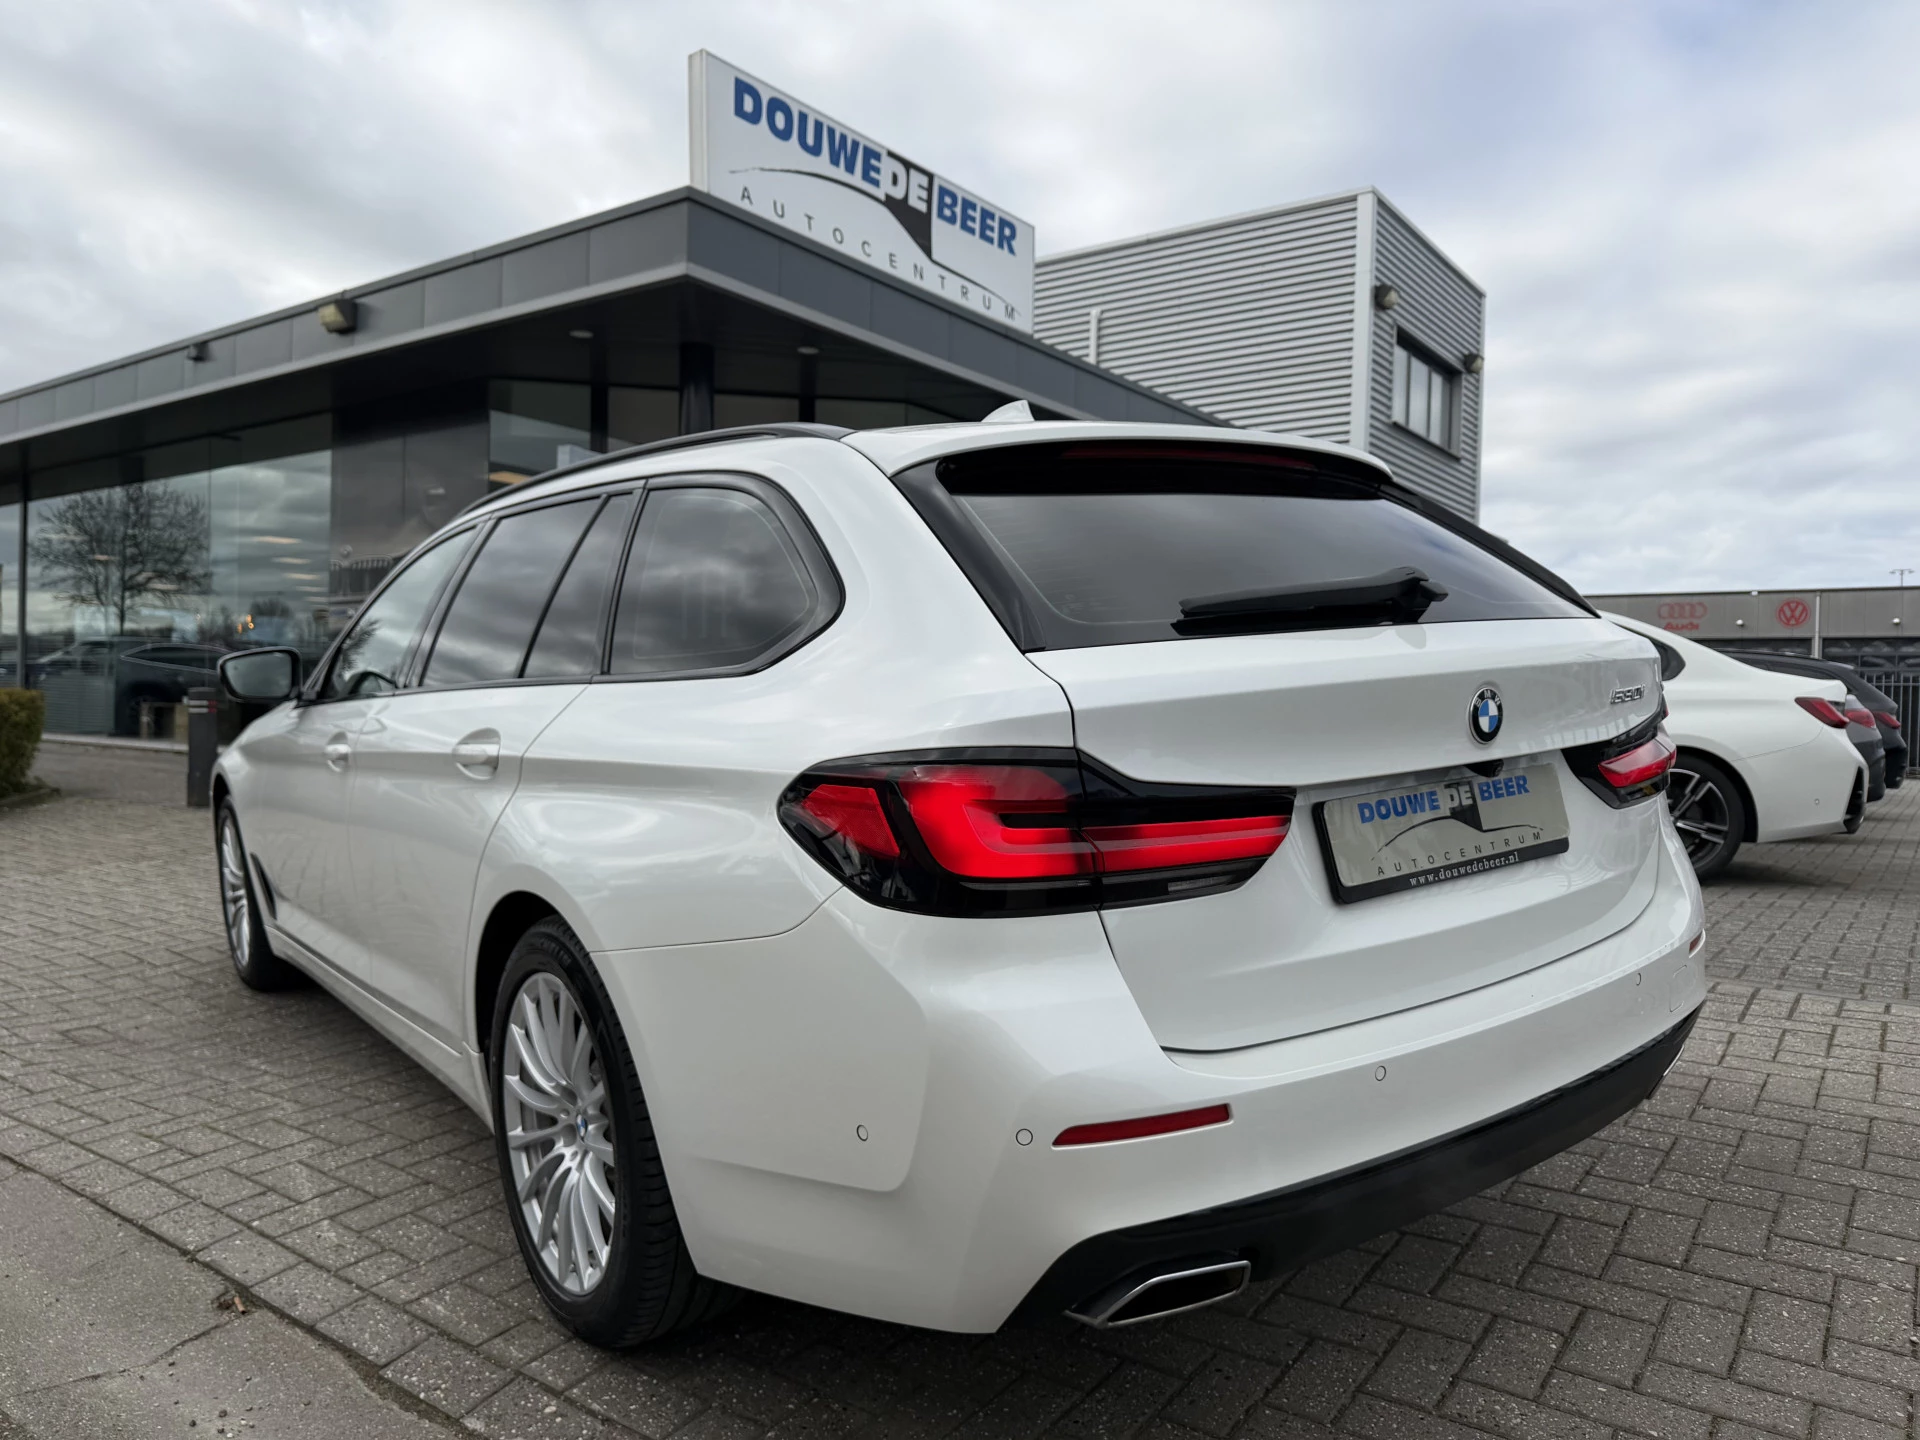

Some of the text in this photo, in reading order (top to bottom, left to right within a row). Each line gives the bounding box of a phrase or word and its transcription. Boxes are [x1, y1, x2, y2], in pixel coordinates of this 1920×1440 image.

[734, 76, 1017, 256] DOUWE DE BEER
[740, 186, 1016, 322] AUTOCENTRUM
[1474, 689, 1501, 708] BMW
[1357, 775, 1530, 824] DOUWE DE BEER
[1377, 831, 1542, 876] AUTOCENTRUM
[1409, 851, 1519, 886] www.douwedebeer.nl
